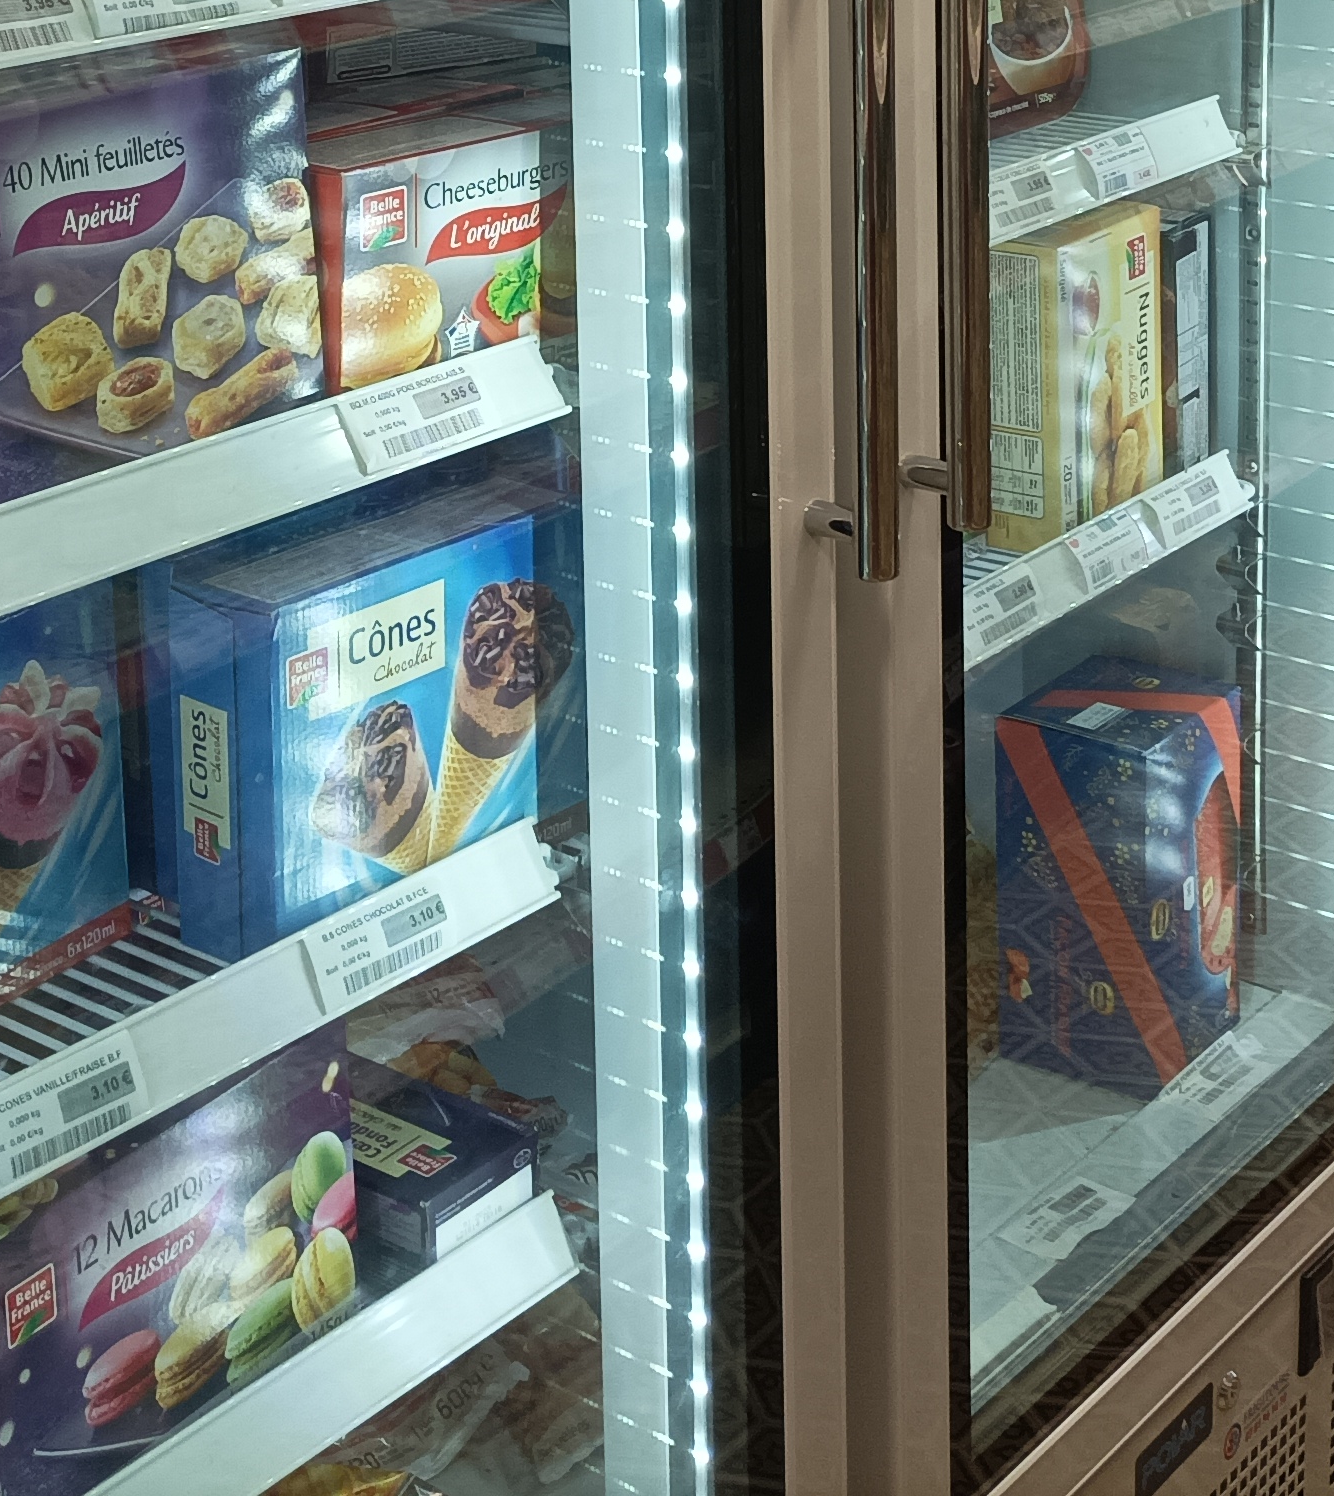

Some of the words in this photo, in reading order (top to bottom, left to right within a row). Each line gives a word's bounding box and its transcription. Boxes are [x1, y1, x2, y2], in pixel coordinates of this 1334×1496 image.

[2, 164, 33, 194] 40
[40, 154, 90, 186] Mini
[94, 130, 185, 173] feuilletés
[370, 196, 400, 216] Belle
[424, 160, 568, 210] Cheeseburgers
[62, 194, 141, 241] Apéritif
[450, 203, 540, 249] L'original
[1136, 292, 1151, 400] Nuggets
[441, 385, 467, 405] 3,95
[467, 381, 479, 394] €
[1063, 463, 1073, 482] 20
[349, 607, 437, 665] Cônes
[290, 667, 327, 685] France
[296, 655, 324, 672] Belle
[374, 641, 436, 683] Chocolat
[189, 710, 209, 800] Cônes
[209, 715, 222, 783] Chocolat
[196, 822, 204, 851] Belle
[335, 917, 364, 936] CONES
[363, 898, 405, 922] CHOCOLAT
[408, 906, 433, 928] 3,10
[435, 900, 445, 914] €
[33, 1056, 107, 1097] VANILLE/FRAISE
[107, 1049, 122, 1064] B.F
[90, 1076, 119, 1101] 3,10
[122, 1069, 134, 1085] €
[72, 1241, 99, 1275] 12
[105, 1161, 227, 1258] Macarons
[110, 1226, 196, 1303] Pâtissiers
[10, 1289, 53, 1324] France
[14, 1276, 48, 1306] Belle
